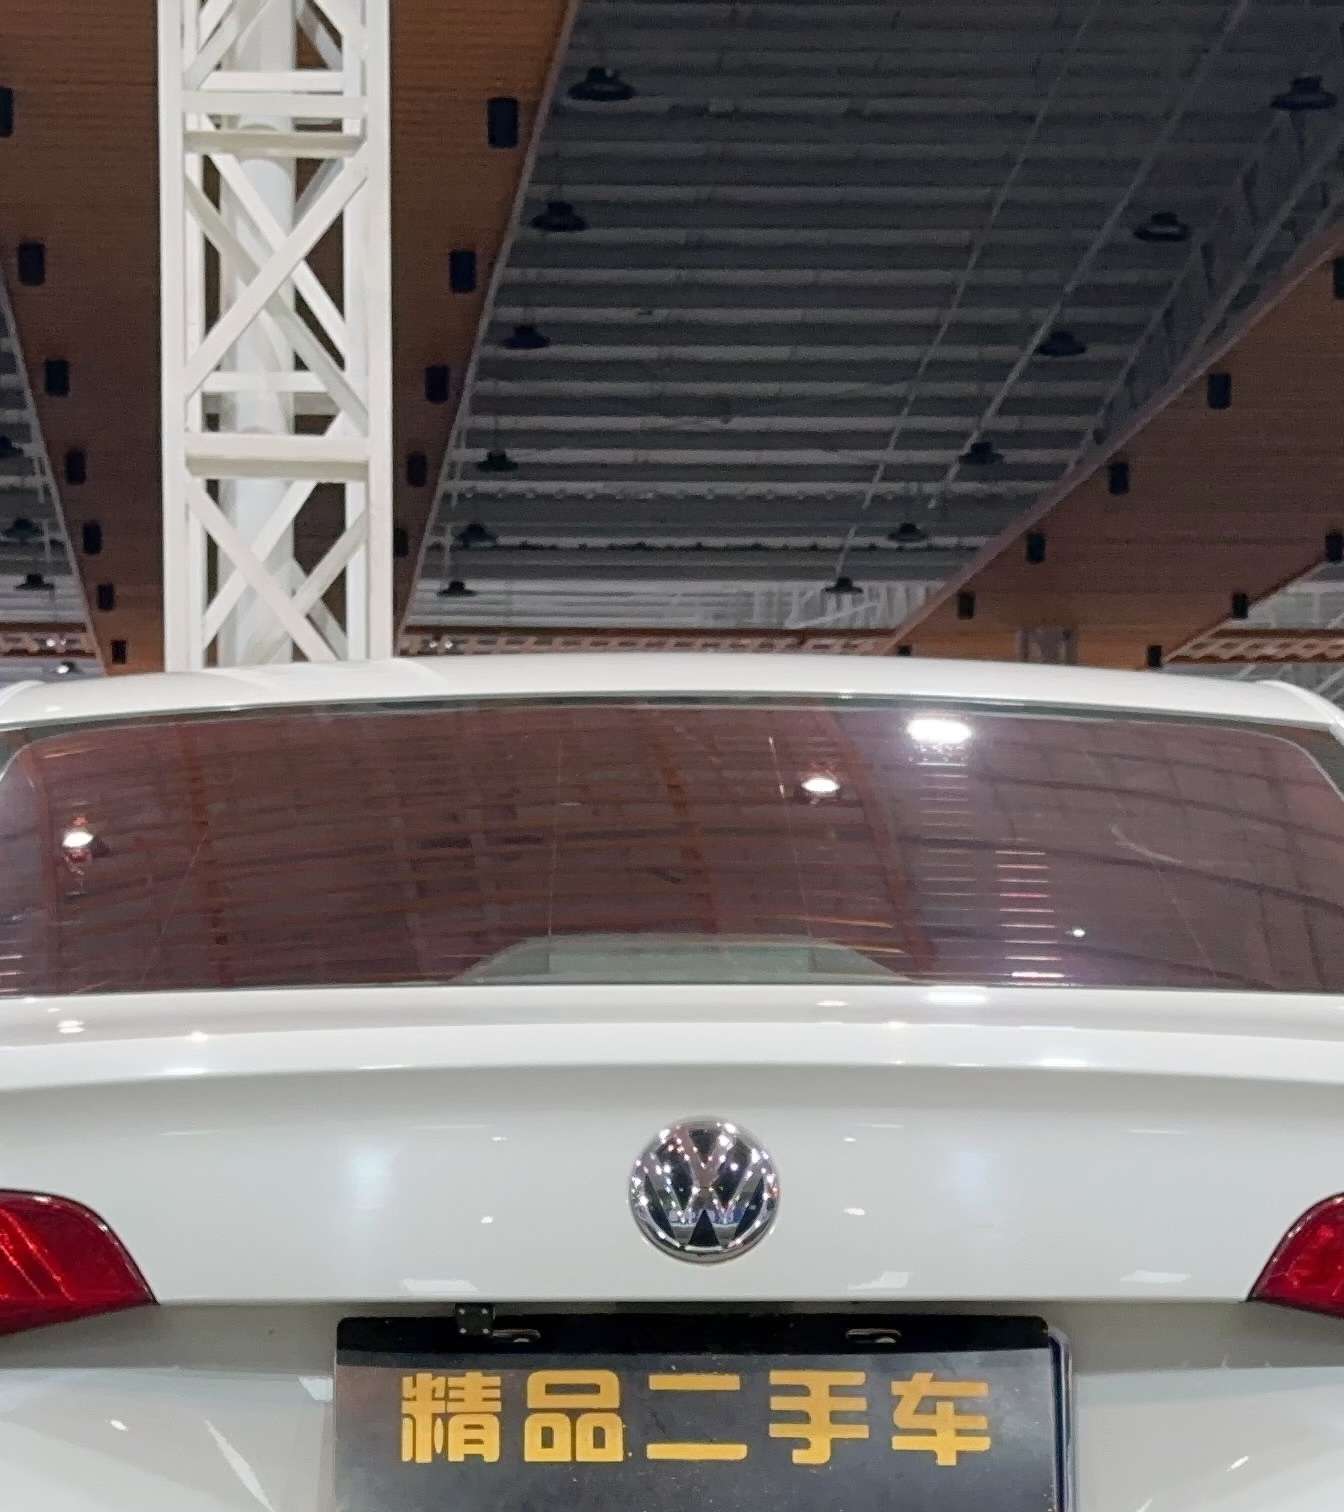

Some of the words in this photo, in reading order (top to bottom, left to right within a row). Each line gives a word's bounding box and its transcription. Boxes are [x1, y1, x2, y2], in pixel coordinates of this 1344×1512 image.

[400, 1369, 994, 1467] 精品二手车
